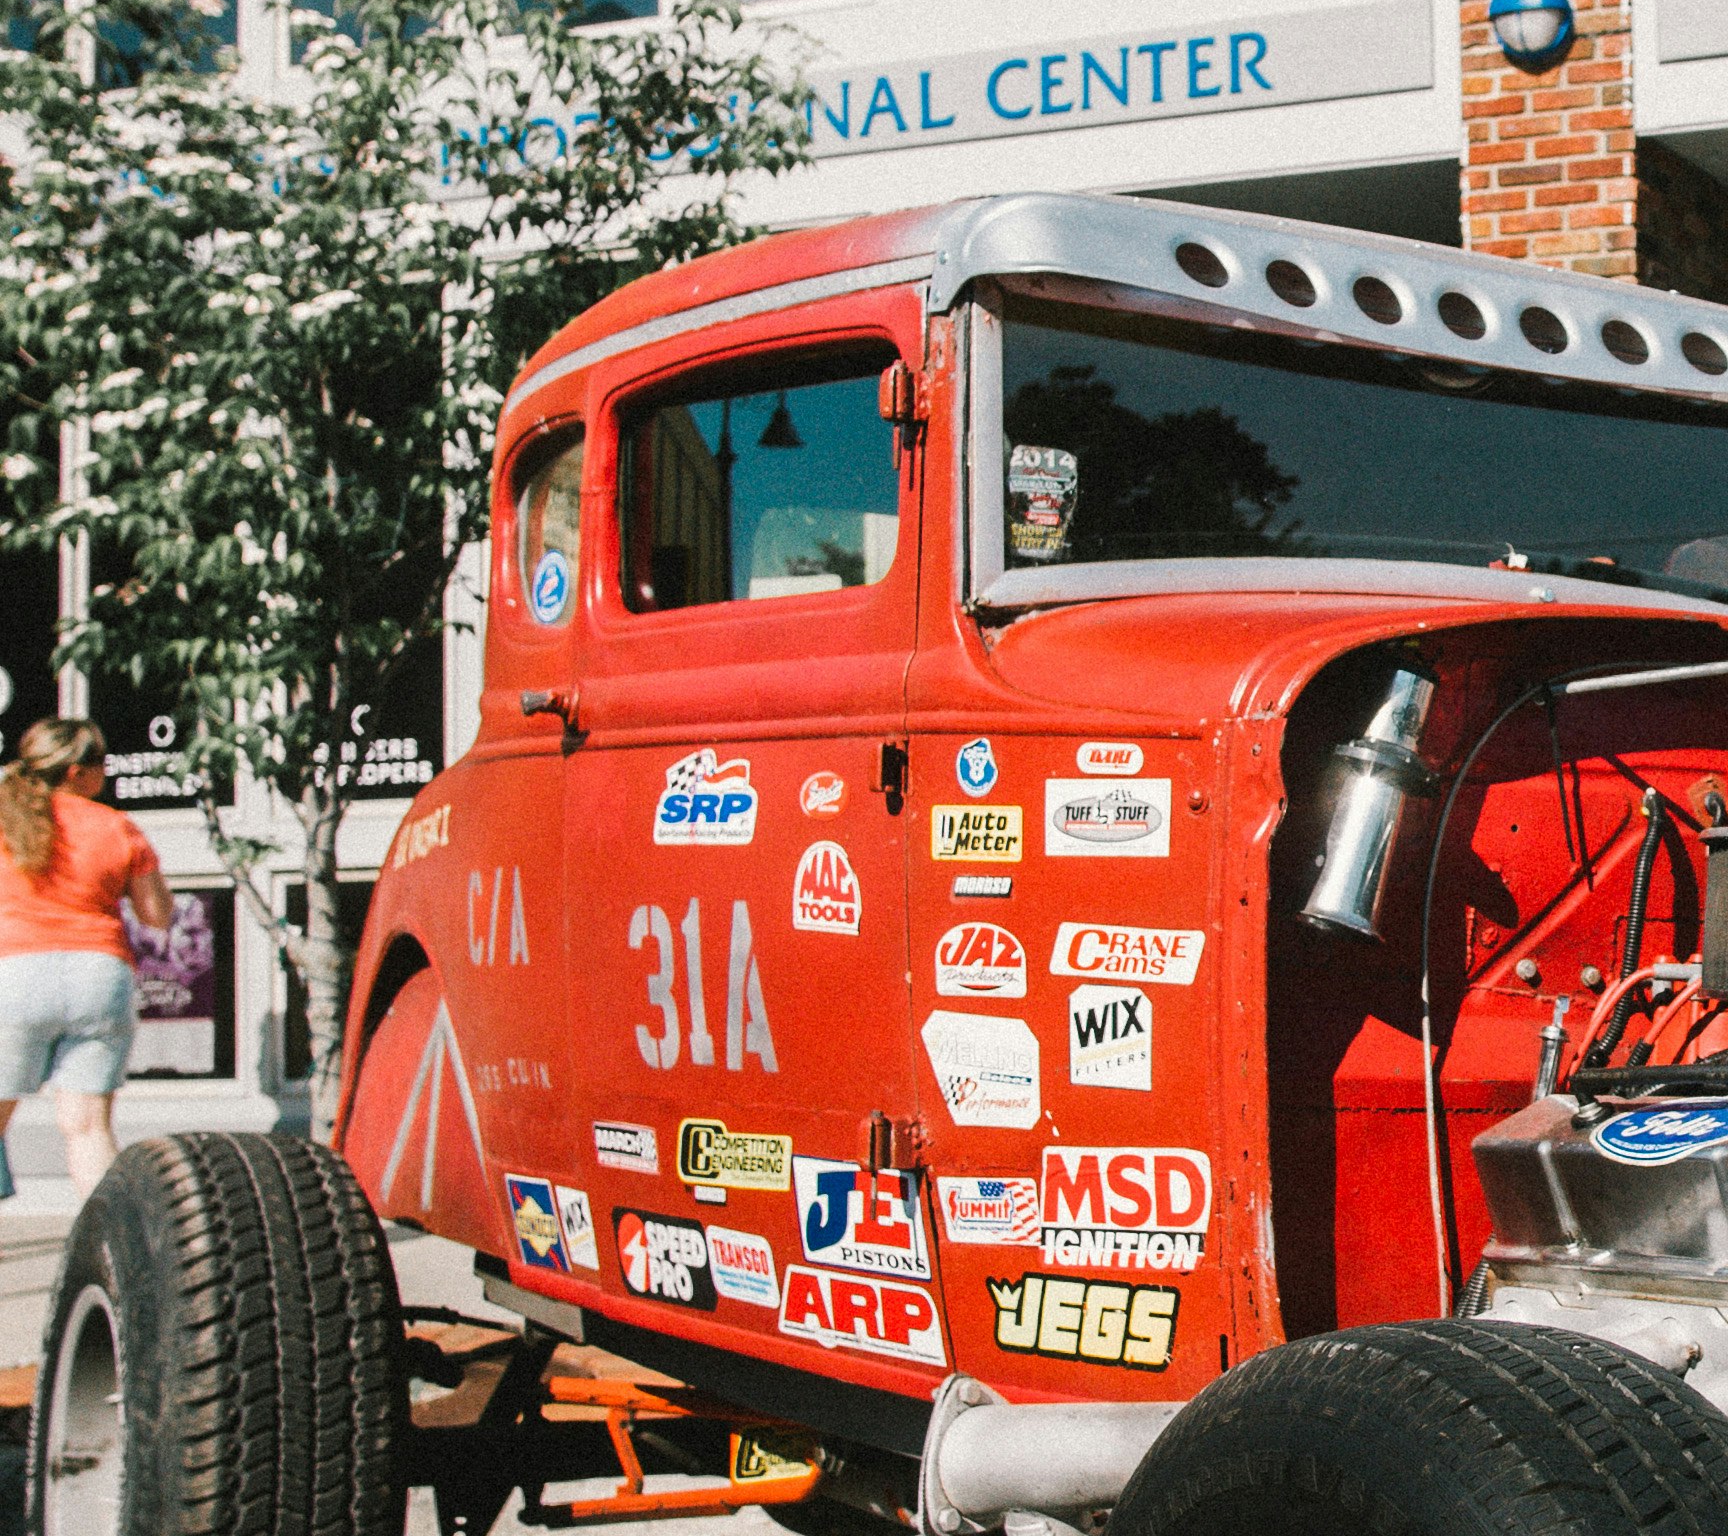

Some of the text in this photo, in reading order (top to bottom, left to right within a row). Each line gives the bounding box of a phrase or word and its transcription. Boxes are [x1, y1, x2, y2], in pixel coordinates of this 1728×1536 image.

[986, 31, 1273, 120] CENTER
[661, 793, 752, 823] SRP
[959, 812, 1007, 831] Auto
[1066, 806, 1149, 821] TUFF STUFF
[954, 832, 1018, 852] Meter
[467, 865, 531, 966] C/A
[800, 903, 855, 924] TOOLS
[940, 927, 1023, 967] JAZ
[1067, 929, 1191, 971] CRANE
[628, 896, 780, 1073] 31A
[1073, 995, 1145, 1048] WIX
[1075, 1051, 1147, 1077] FILTERS
[711, 1156, 783, 1174] ENGINEERING
[713, 1135, 784, 1155] COMPETITION
[948, 1190, 1011, 1220] SUMMIT
[1043, 1153, 1206, 1228] MSD
[806, 1170, 911, 1252] JE
[644, 1220, 707, 1268] SPEED
[841, 1247, 928, 1274] PISTONS
[1040, 1229, 1205, 1270] IGNITION
[650, 1262, 693, 1302] PRO
[784, 1271, 934, 1346] ARP
[999, 1277, 1177, 1366] JEGS
